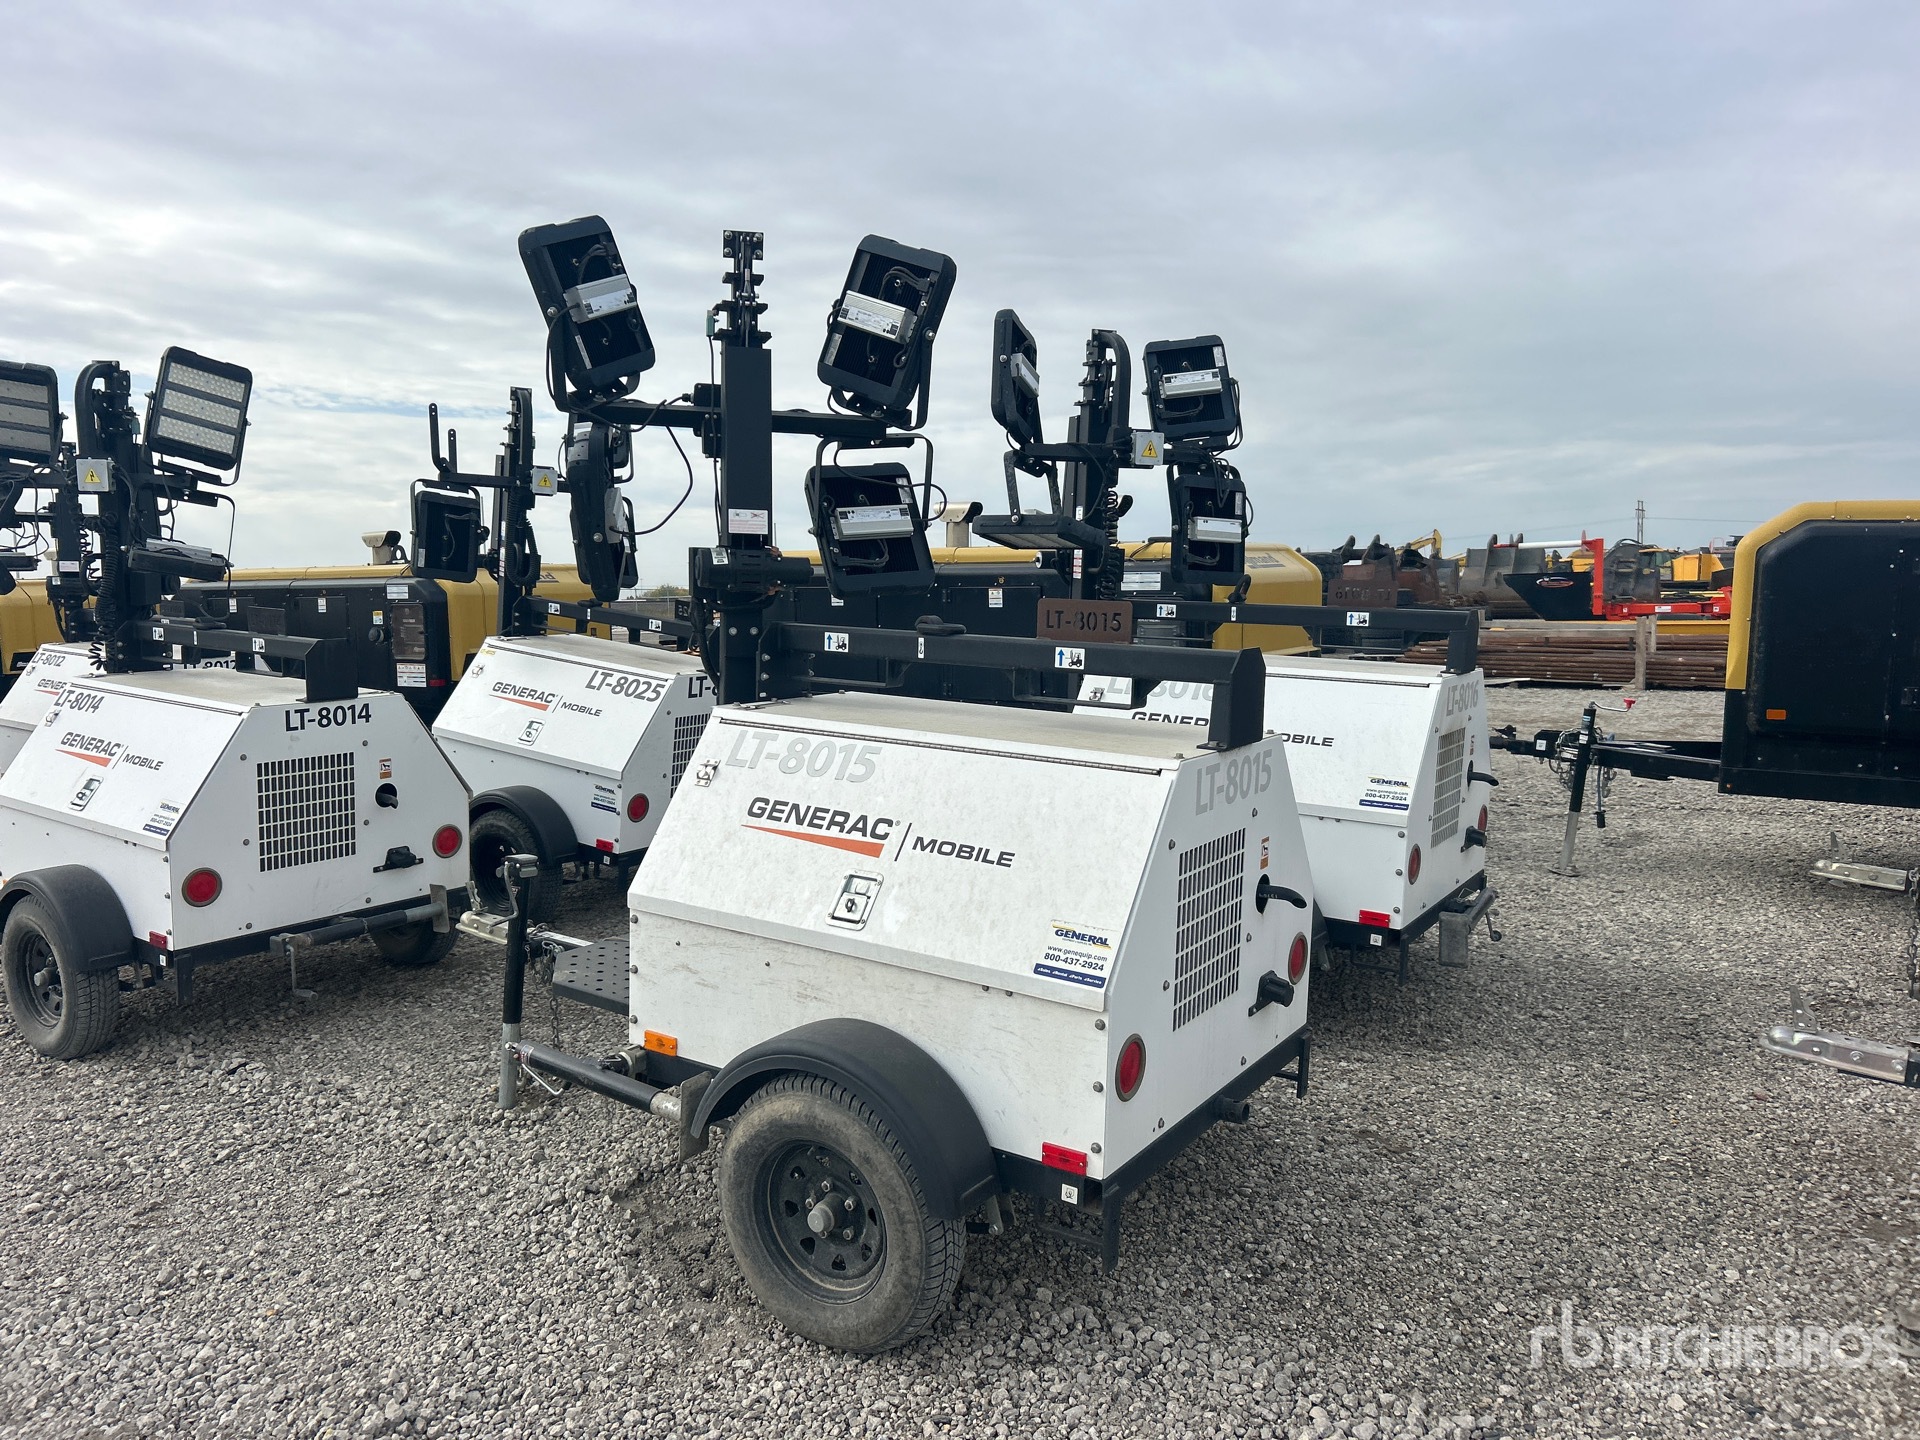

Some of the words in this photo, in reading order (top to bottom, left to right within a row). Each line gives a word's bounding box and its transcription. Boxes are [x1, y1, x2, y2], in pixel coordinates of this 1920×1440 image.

[1046, 609, 1122, 633] LT-8015
[31, 652, 66, 667] LT-8012
[492, 682, 554, 704] GENERAC
[560, 701, 603, 717] MOBILE
[585, 670, 665, 702] LT-8025
[1446, 679, 1479, 717] LT-8016
[54, 689, 105, 714] LT-8014
[285, 702, 372, 732] LT-8014
[60, 732, 121, 757] GENERAC
[122, 753, 164, 771] MOBILE
[1281, 733, 1335, 748] OBILE
[725, 730, 883, 783] LT-8015
[1195, 748, 1273, 817] LT-8015
[1369, 778, 1409, 788] GENERAL
[746, 796, 894, 841] GENERAC
[911, 836, 1016, 868] MOBILE
[1054, 929, 1110, 947] GENERAL
[1043, 952, 1105, 972] 800-437-2924
[1047, 945, 1108, 962] www.genequip.com
